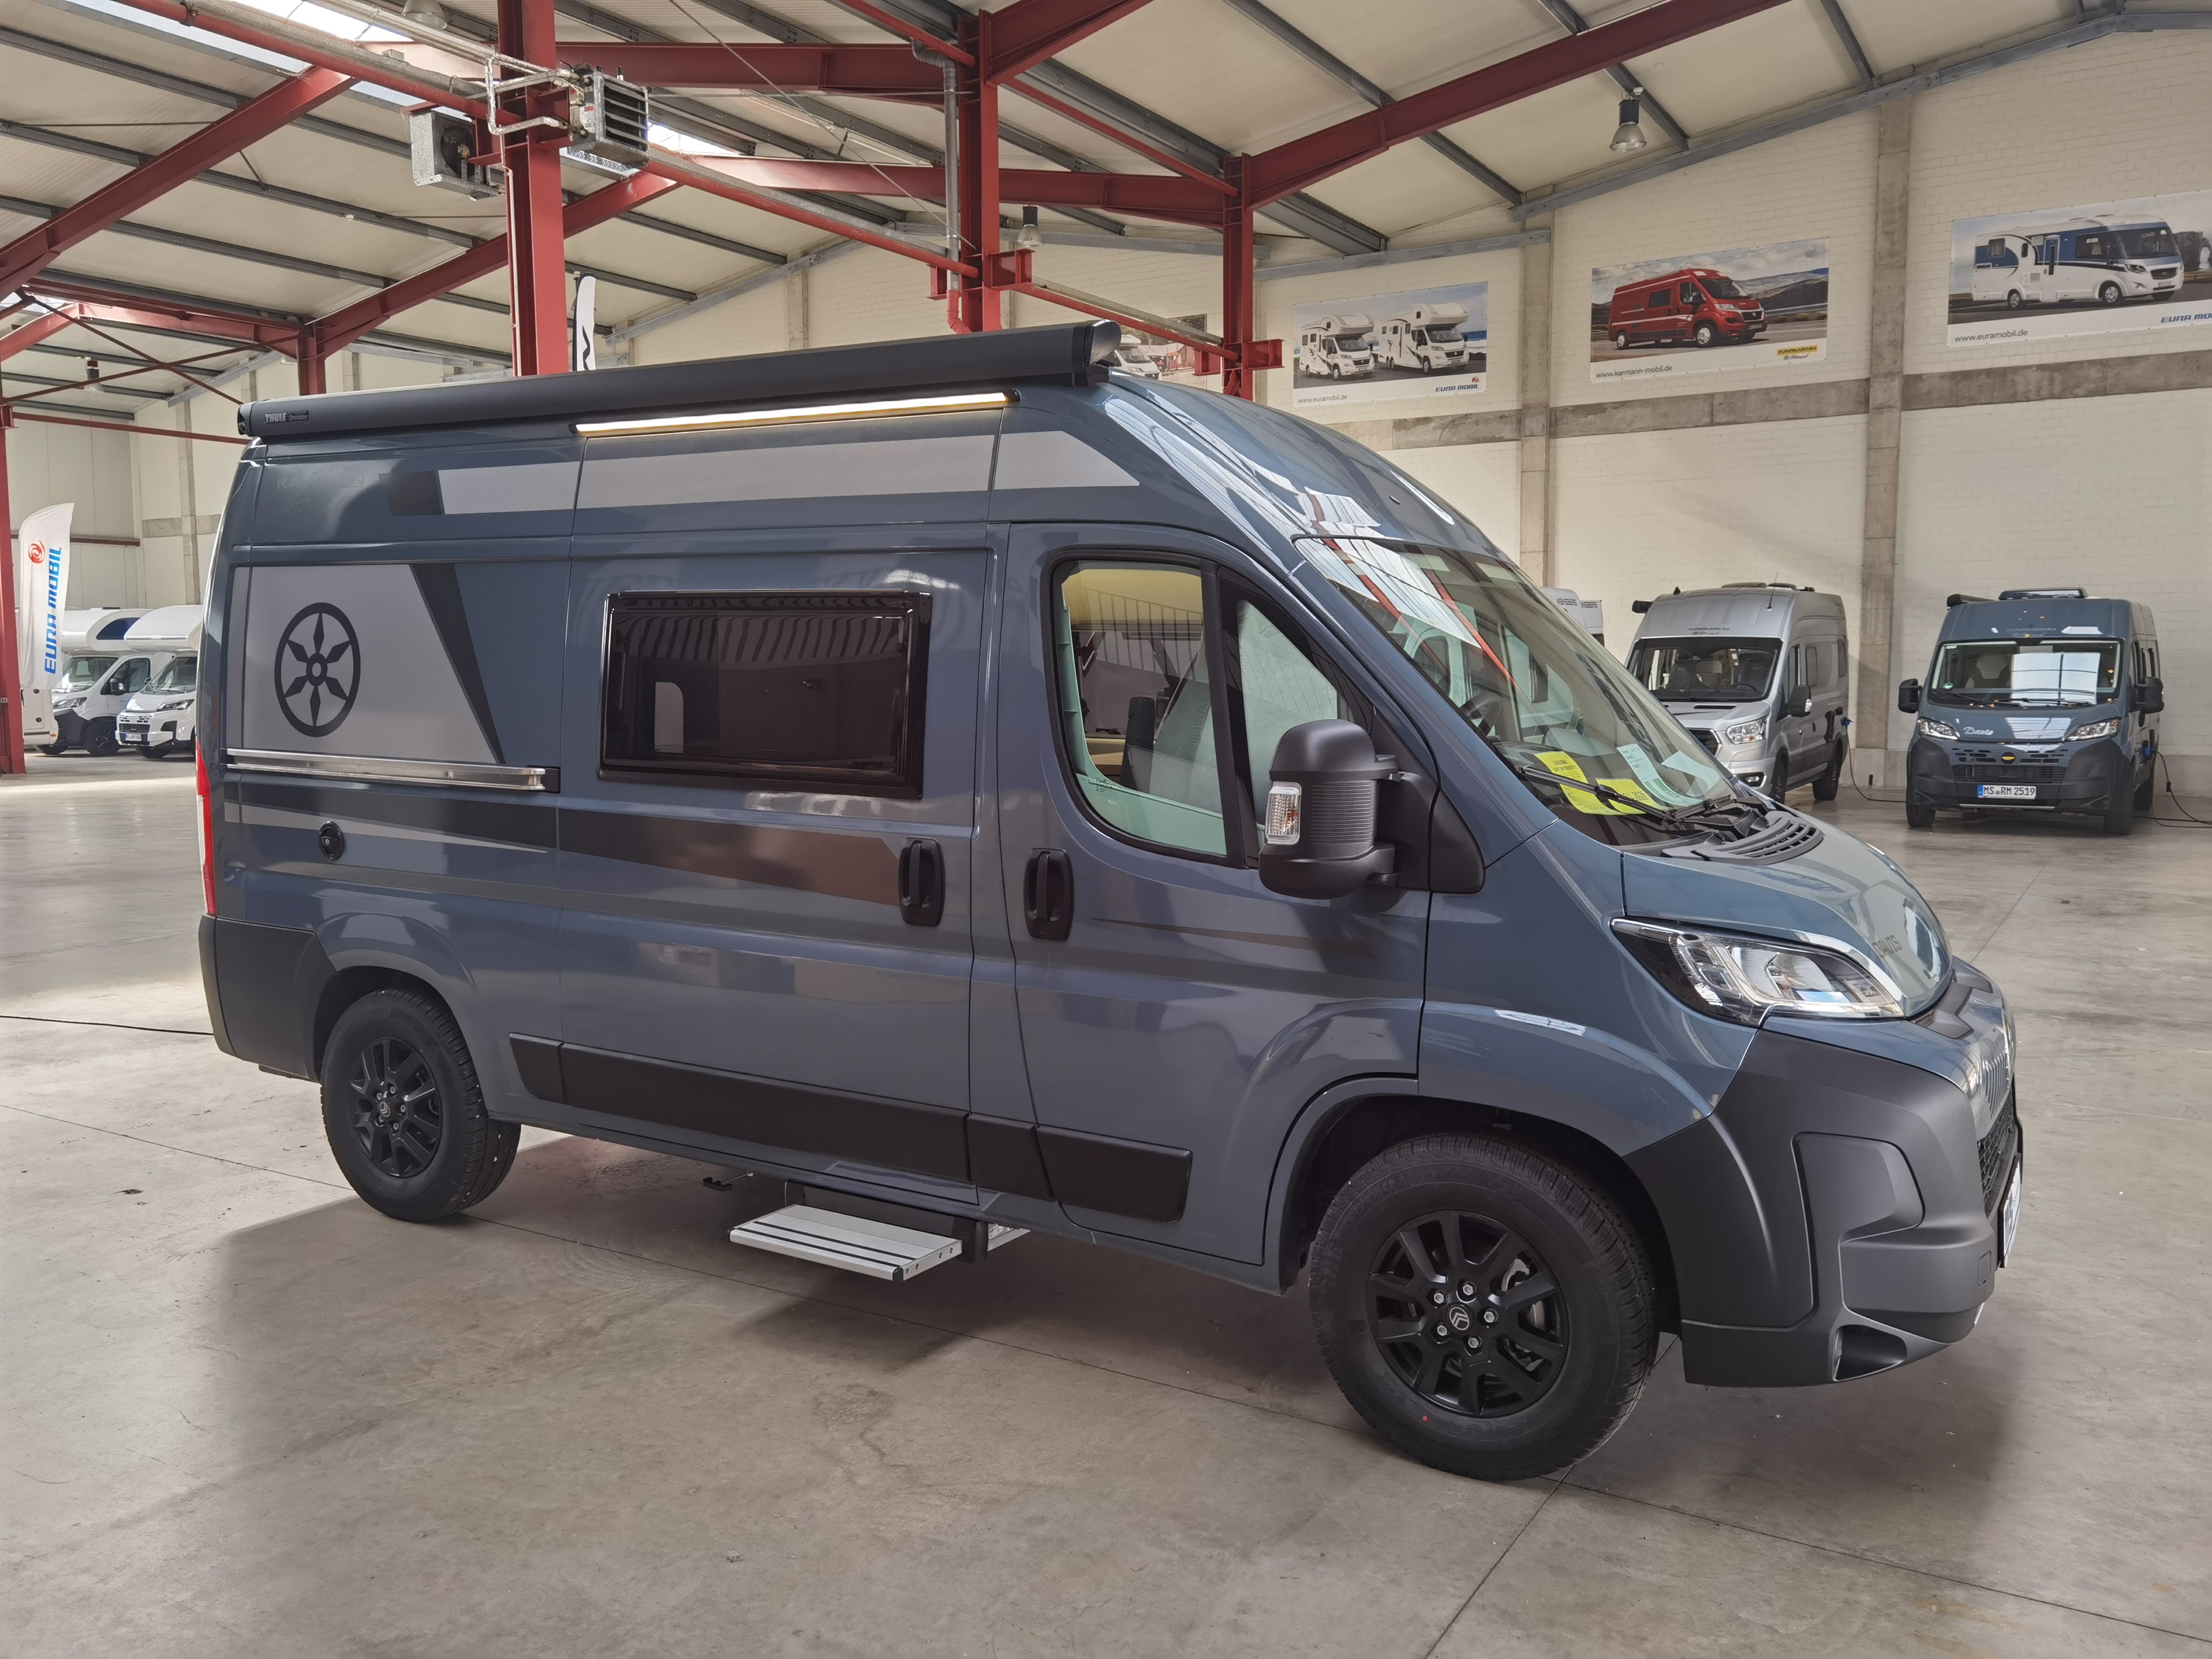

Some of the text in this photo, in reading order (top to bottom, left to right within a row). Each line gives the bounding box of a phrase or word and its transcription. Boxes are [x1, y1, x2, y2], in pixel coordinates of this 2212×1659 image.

[2161, 314, 2192, 323] EURA
[1954, 329, 2028, 342] www.euramobil.de
[1596, 365, 1673, 378] www.karmann-mobil.de
[1298, 394, 1348, 403] www.euramobil.de
[265, 413, 286, 423] THULE
[44, 547, 62, 675] EURA MOBIL
[1984, 786, 2035, 796] MS RM 2519
[1871, 934, 1903, 959] DAVIS
